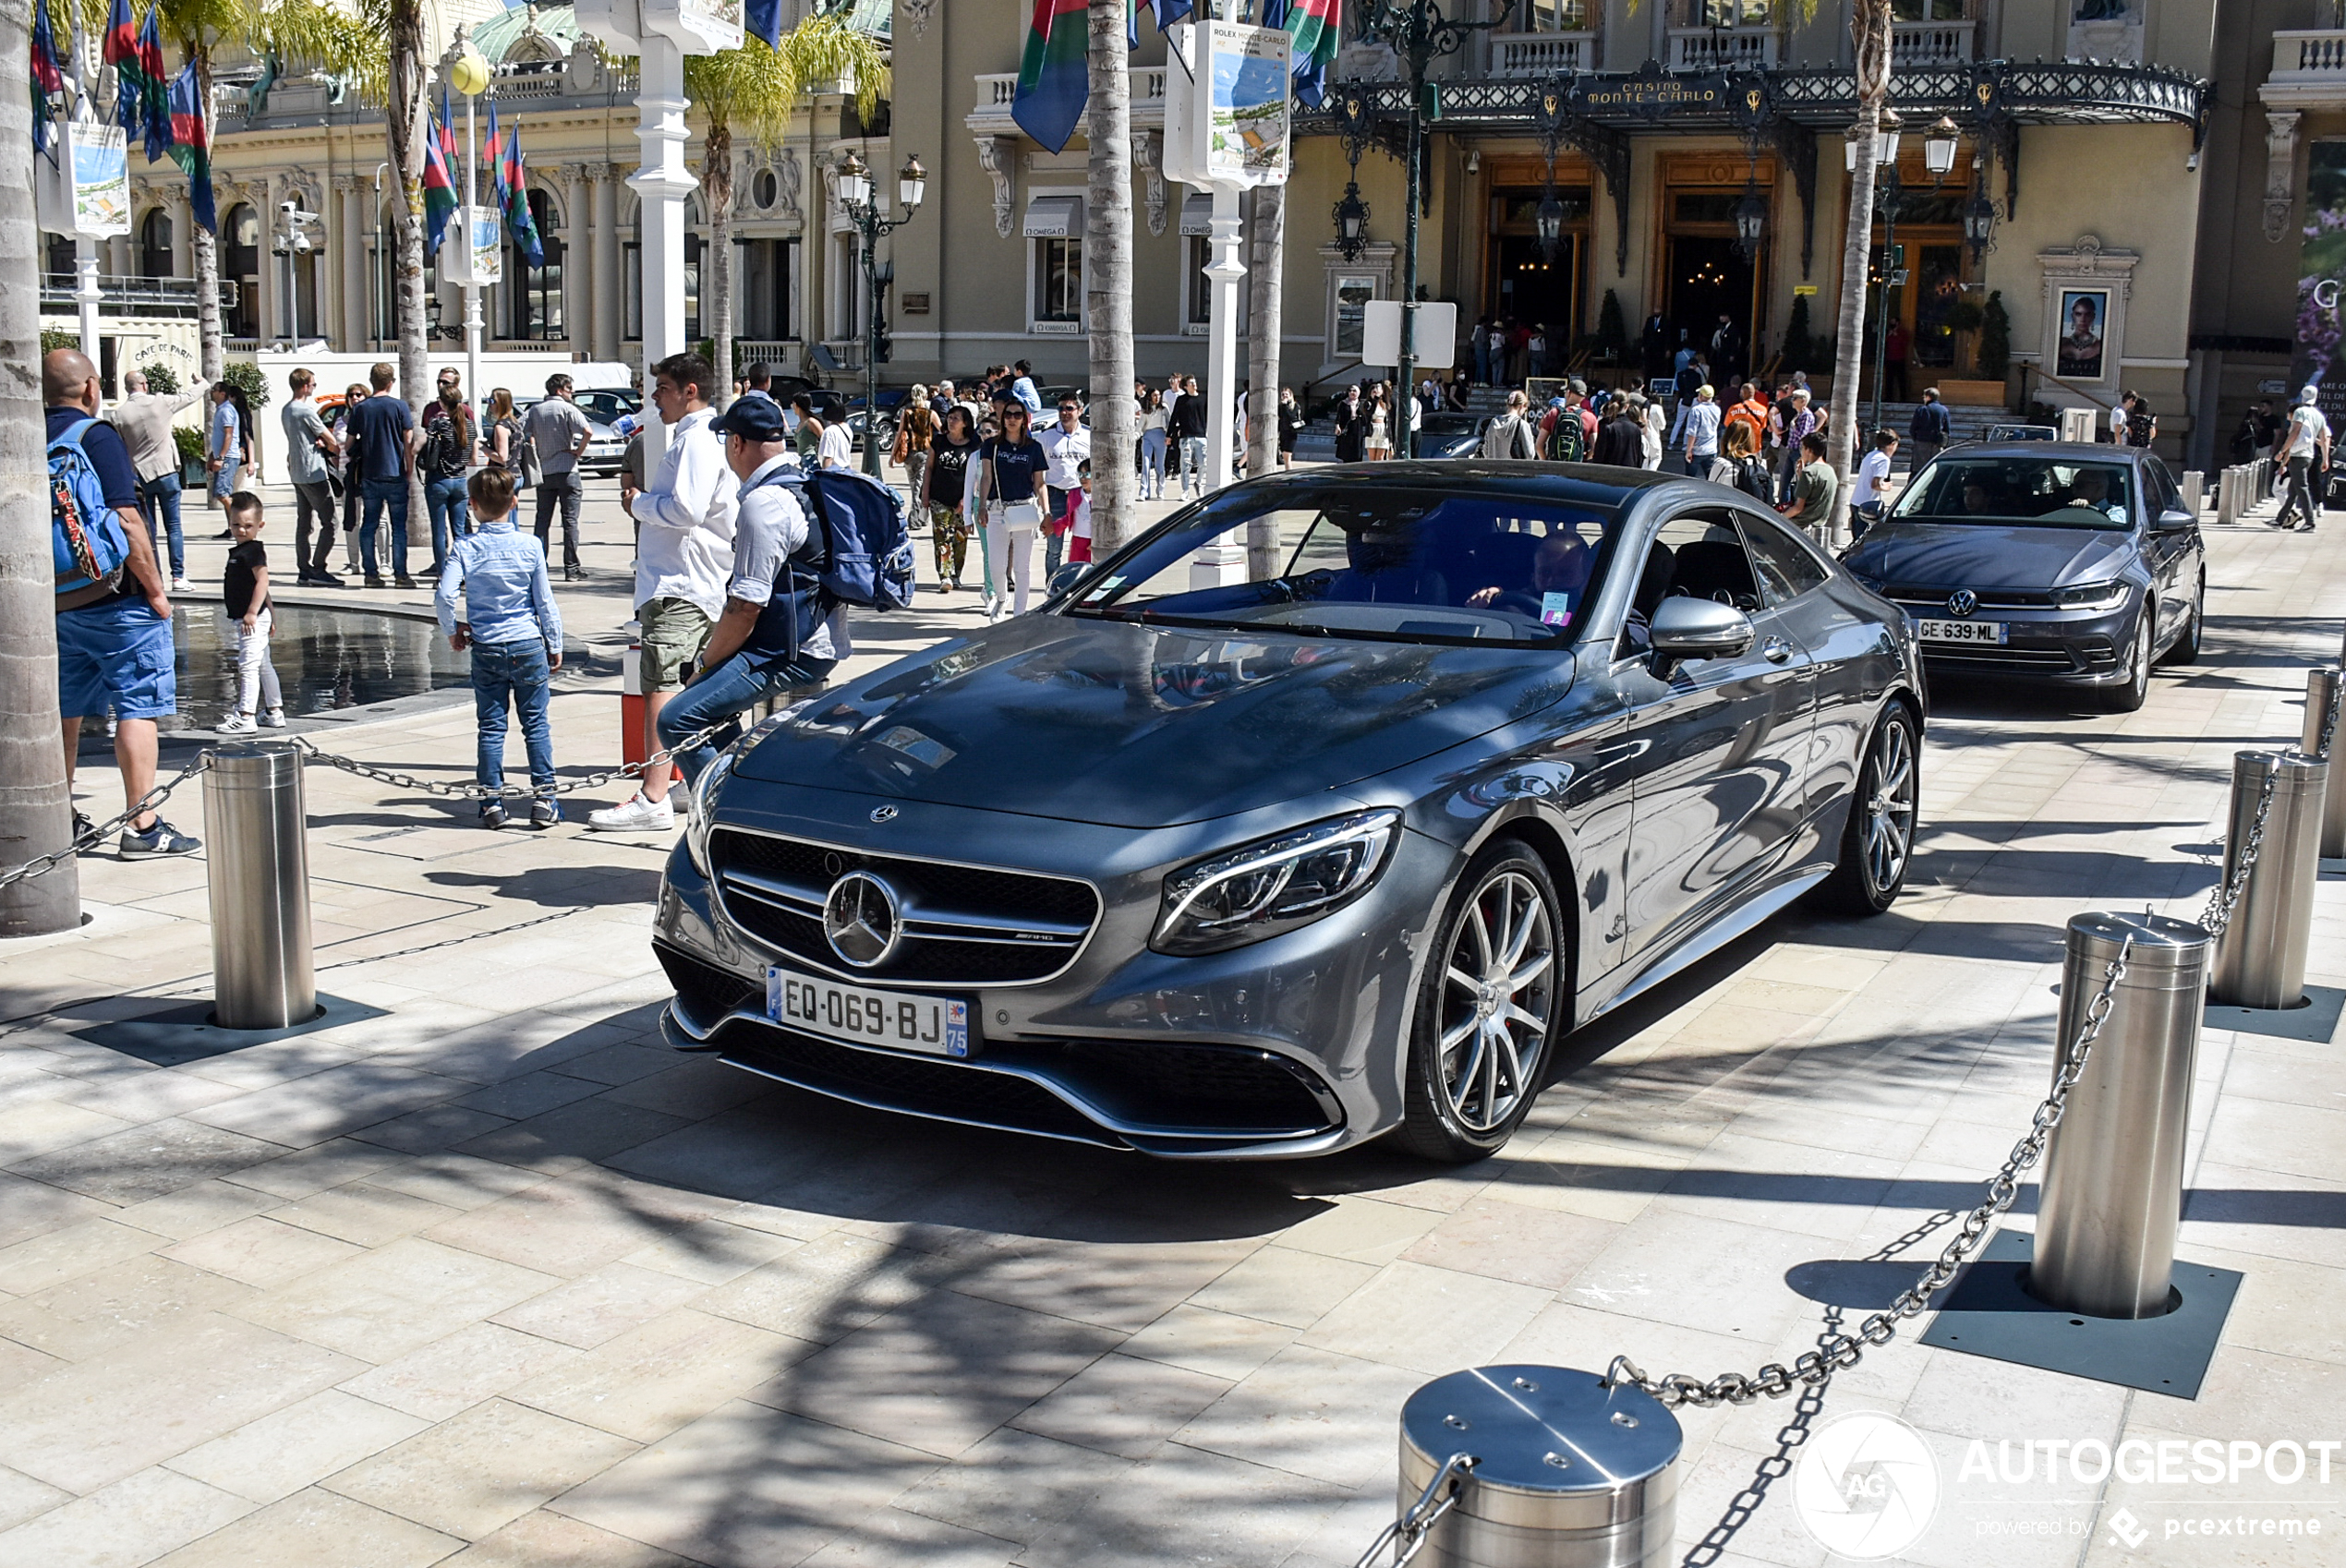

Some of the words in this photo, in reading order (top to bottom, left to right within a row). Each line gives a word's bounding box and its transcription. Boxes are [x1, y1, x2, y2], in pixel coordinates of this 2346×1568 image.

[1214, 29, 1237, 38] ROLEX
[1238, 31, 1287, 45] MONTE-CARLO
[1622, 82, 1681, 92] CASINO
[1588, 90, 1714, 104] MONTE-CARLO
[158, 344, 168, 352] DE
[786, 979, 939, 1043] EQ-069-BJ
[948, 1029, 966, 1049] 75
